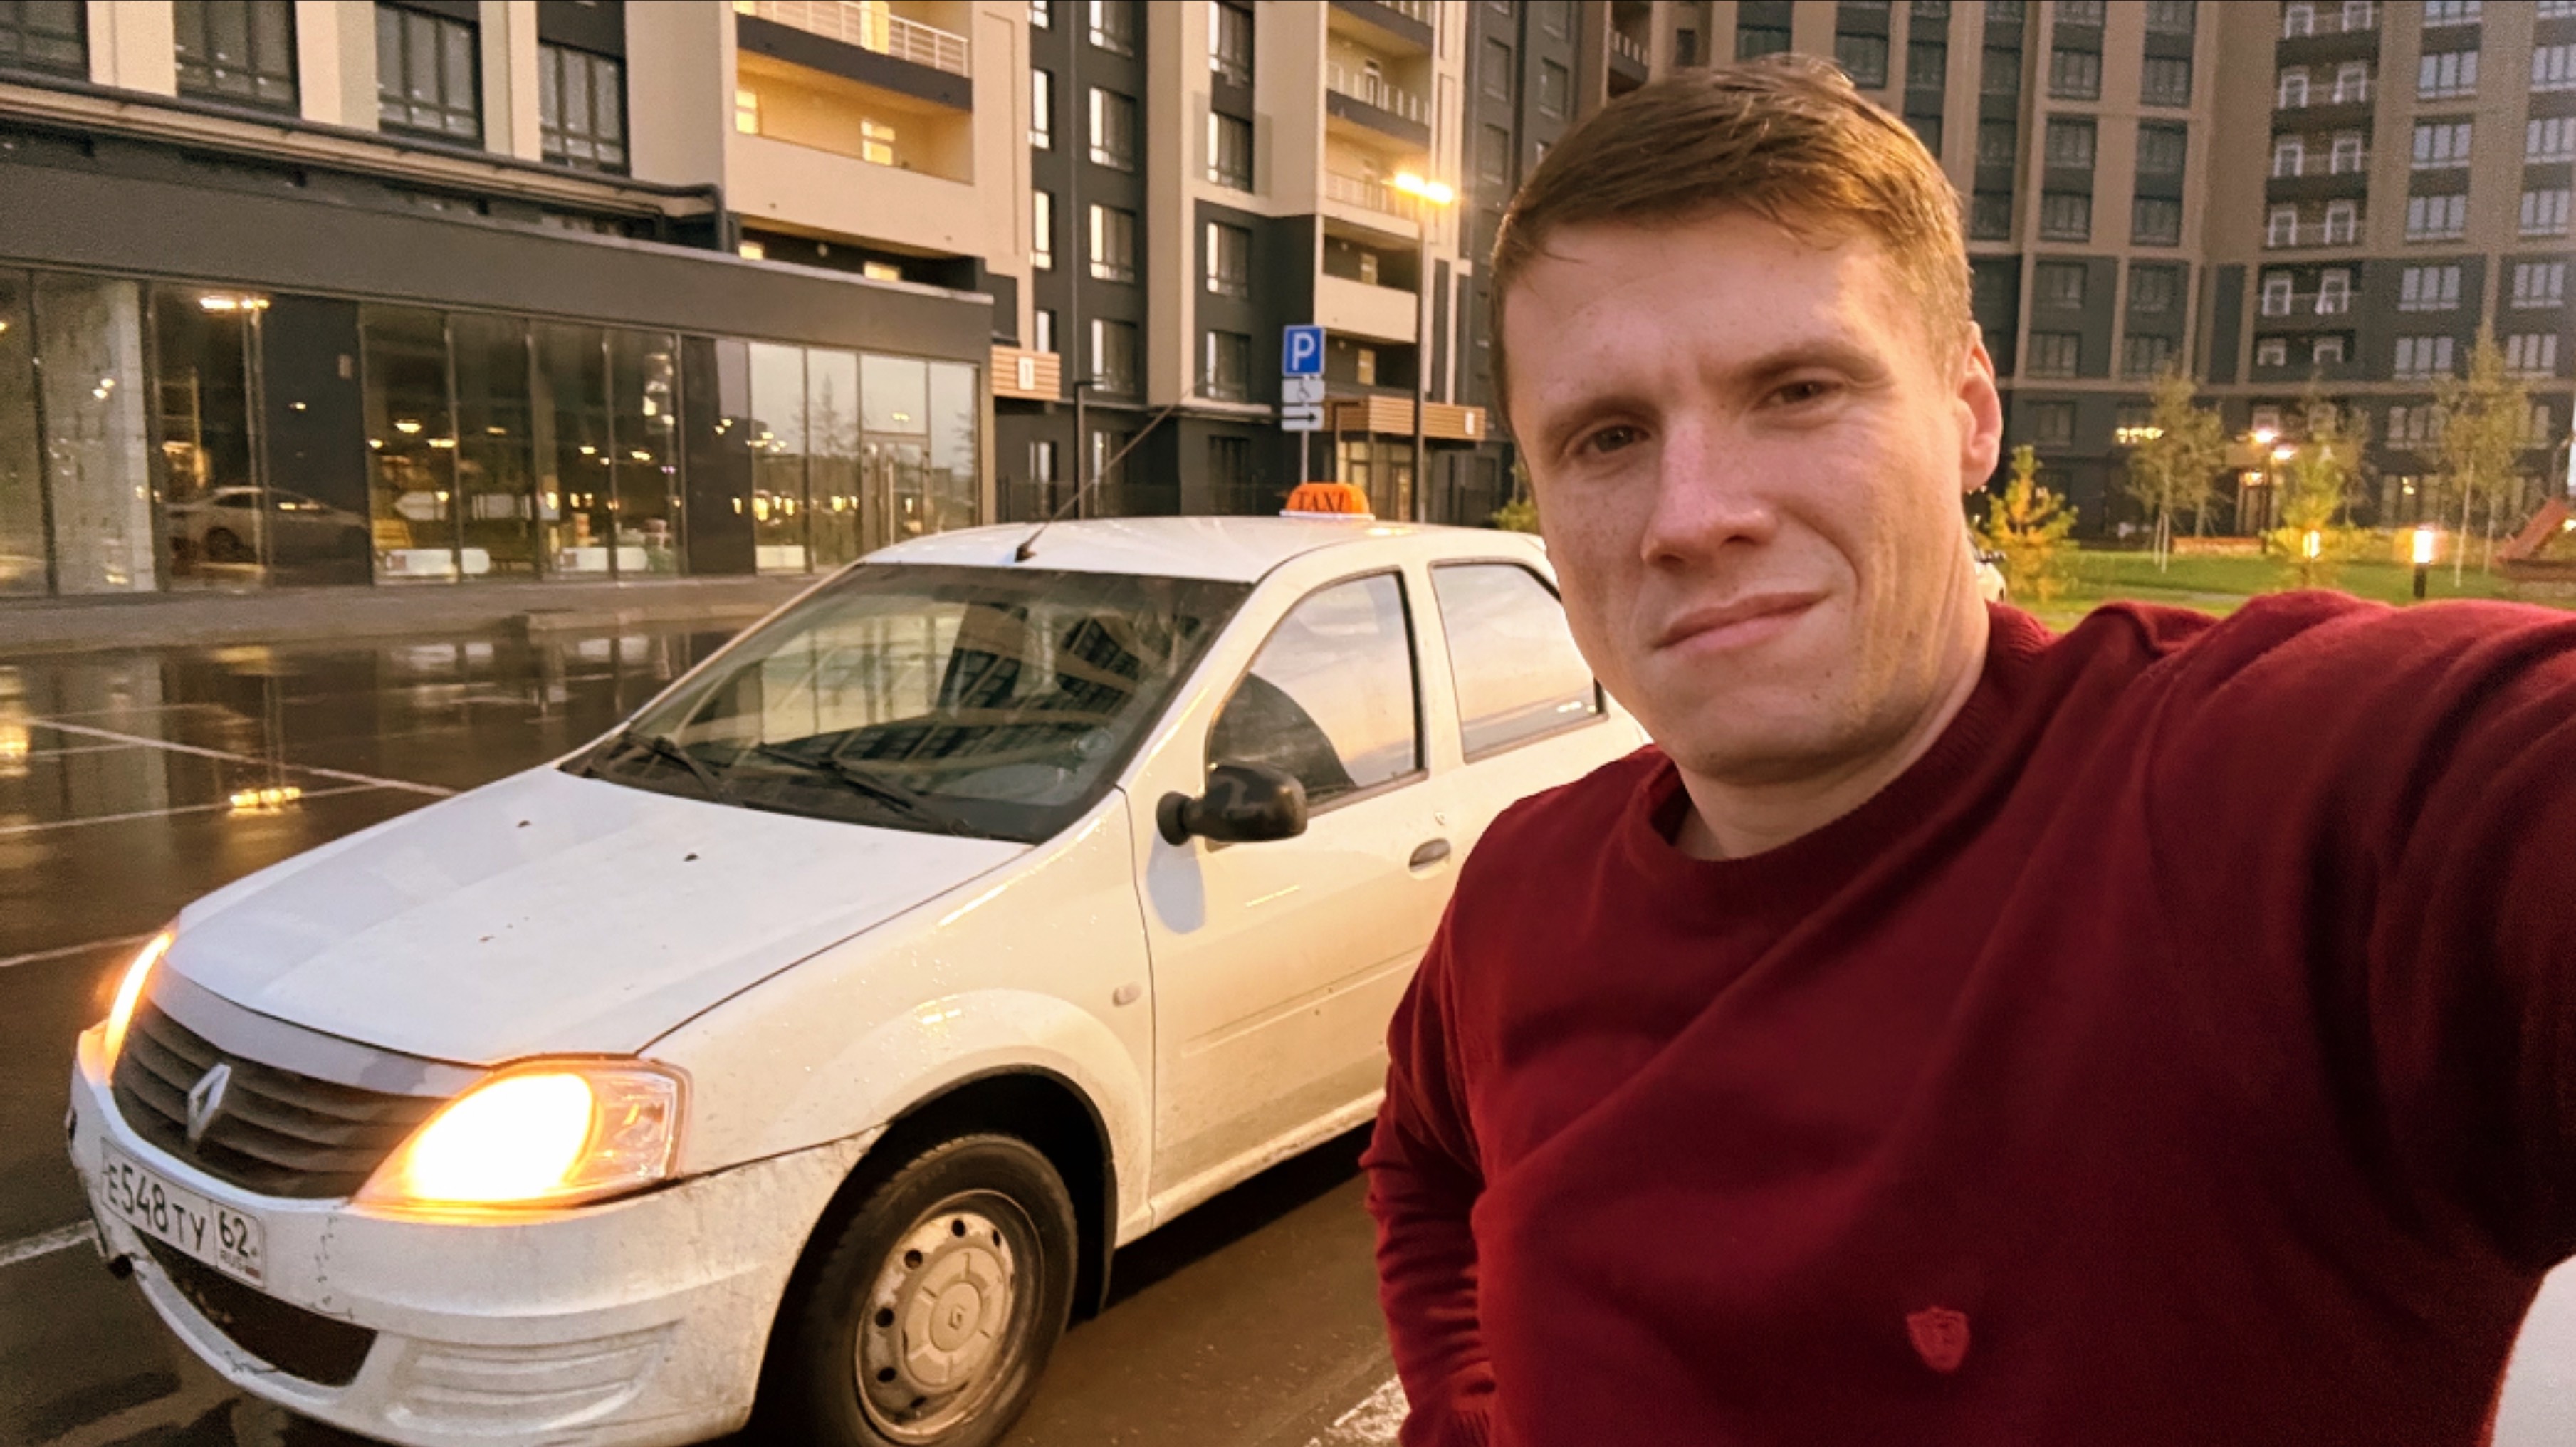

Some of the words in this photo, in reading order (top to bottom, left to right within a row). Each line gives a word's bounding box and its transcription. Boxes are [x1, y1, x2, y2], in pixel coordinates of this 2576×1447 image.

[1292, 332, 1315, 371] P
[1297, 491, 1344, 511] TAXI
[219, 1211, 248, 1258] 62
